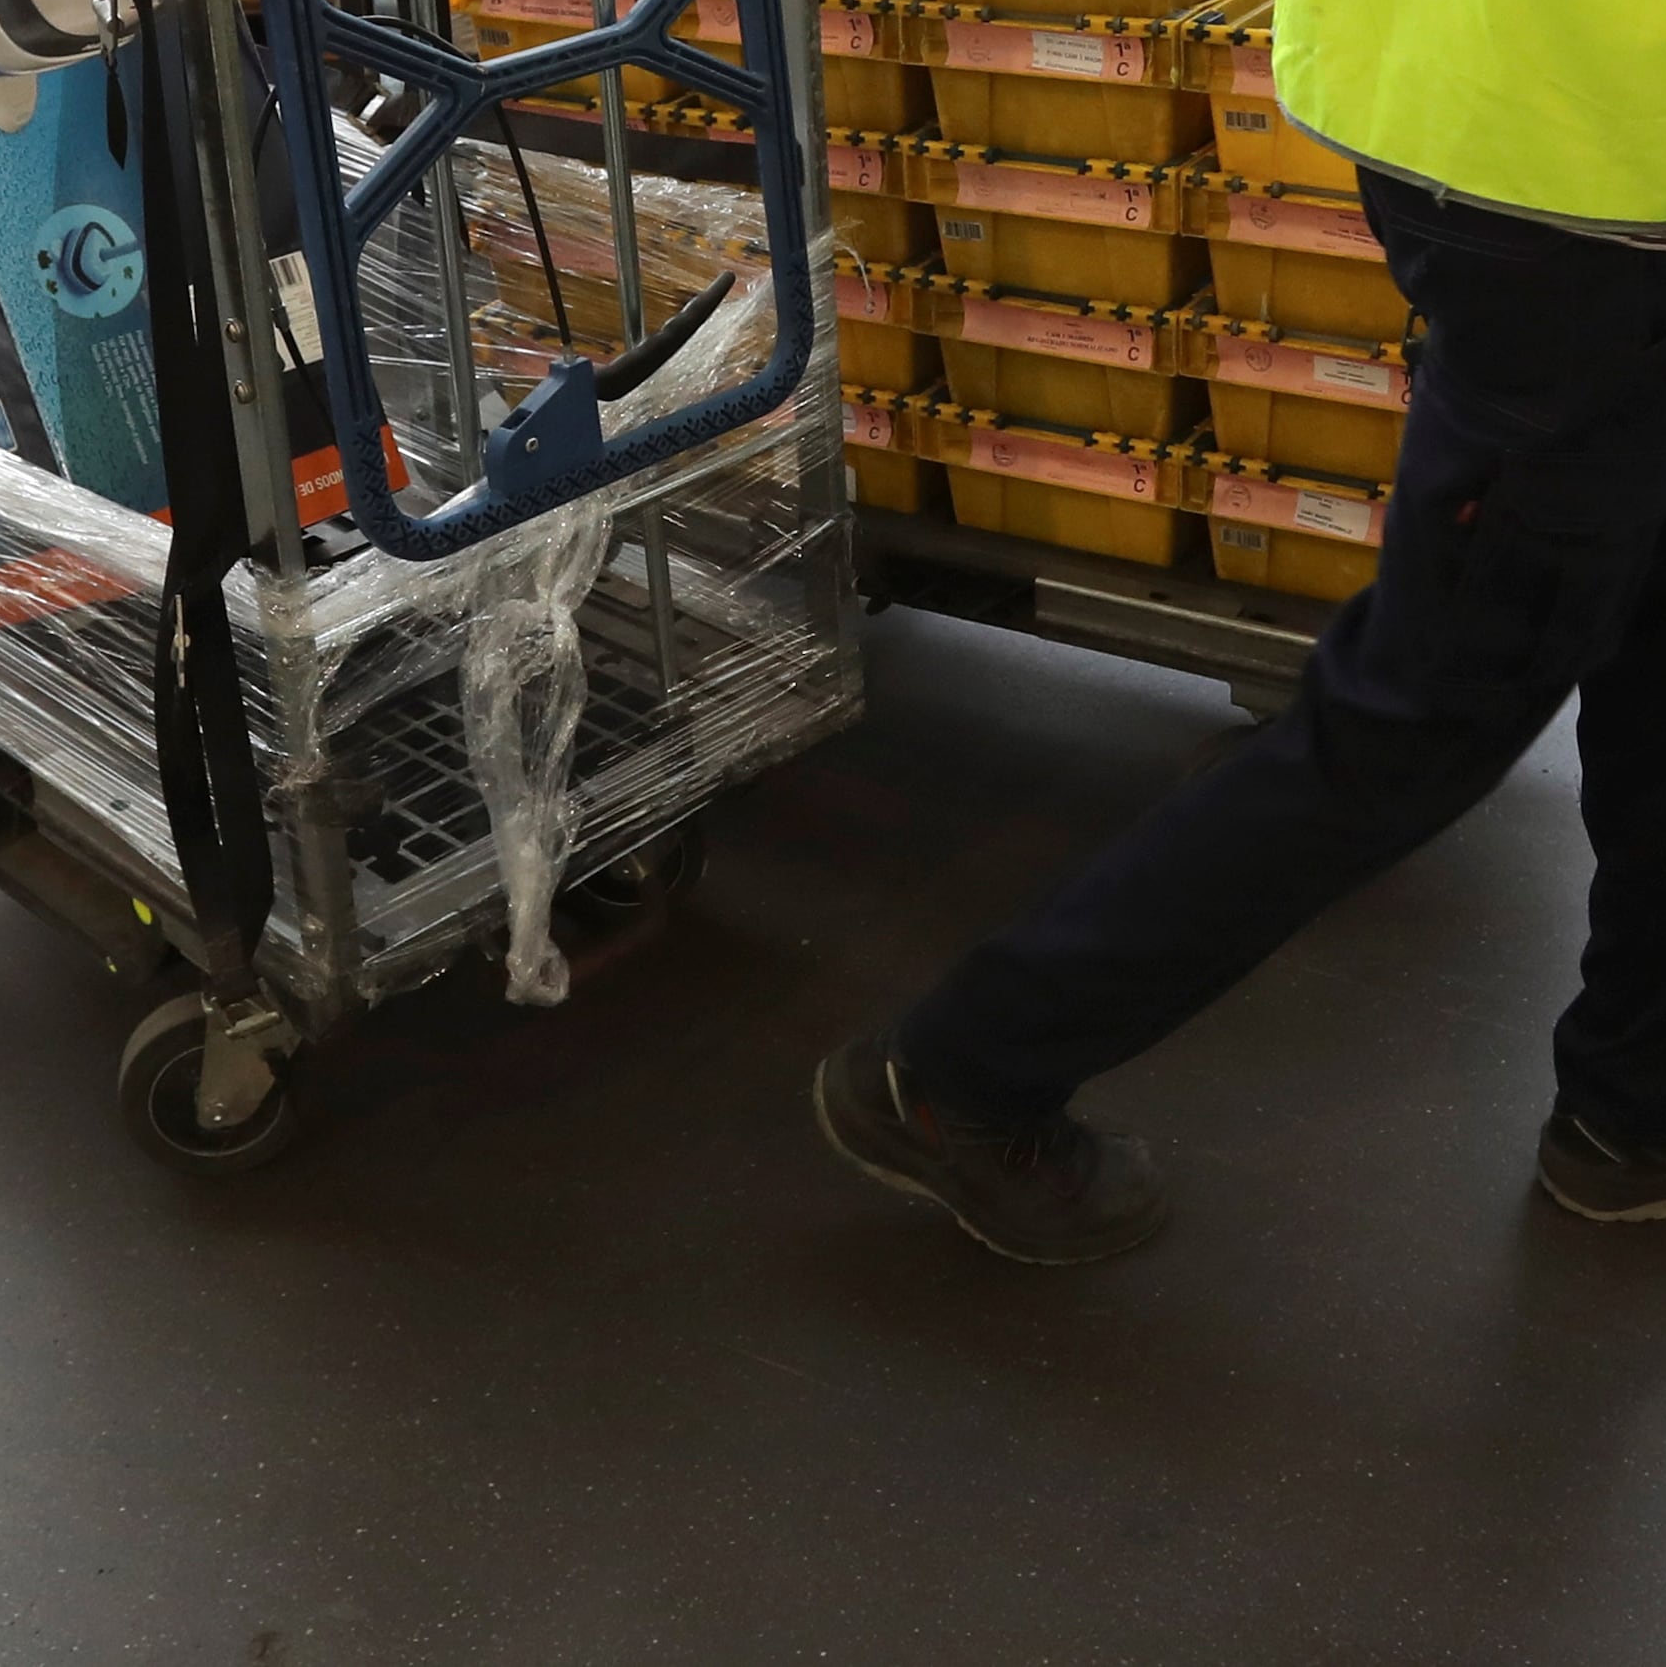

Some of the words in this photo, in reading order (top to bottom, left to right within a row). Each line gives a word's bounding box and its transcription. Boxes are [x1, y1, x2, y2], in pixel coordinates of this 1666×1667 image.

[851, 35, 862, 49] C
[1116, 61, 1130, 76] C
[859, 172, 870, 187] C
[1125, 206, 1139, 221] C
[1128, 346, 1141, 362] C
[868, 426, 880, 440] C
[1133, 478, 1146, 493] C
